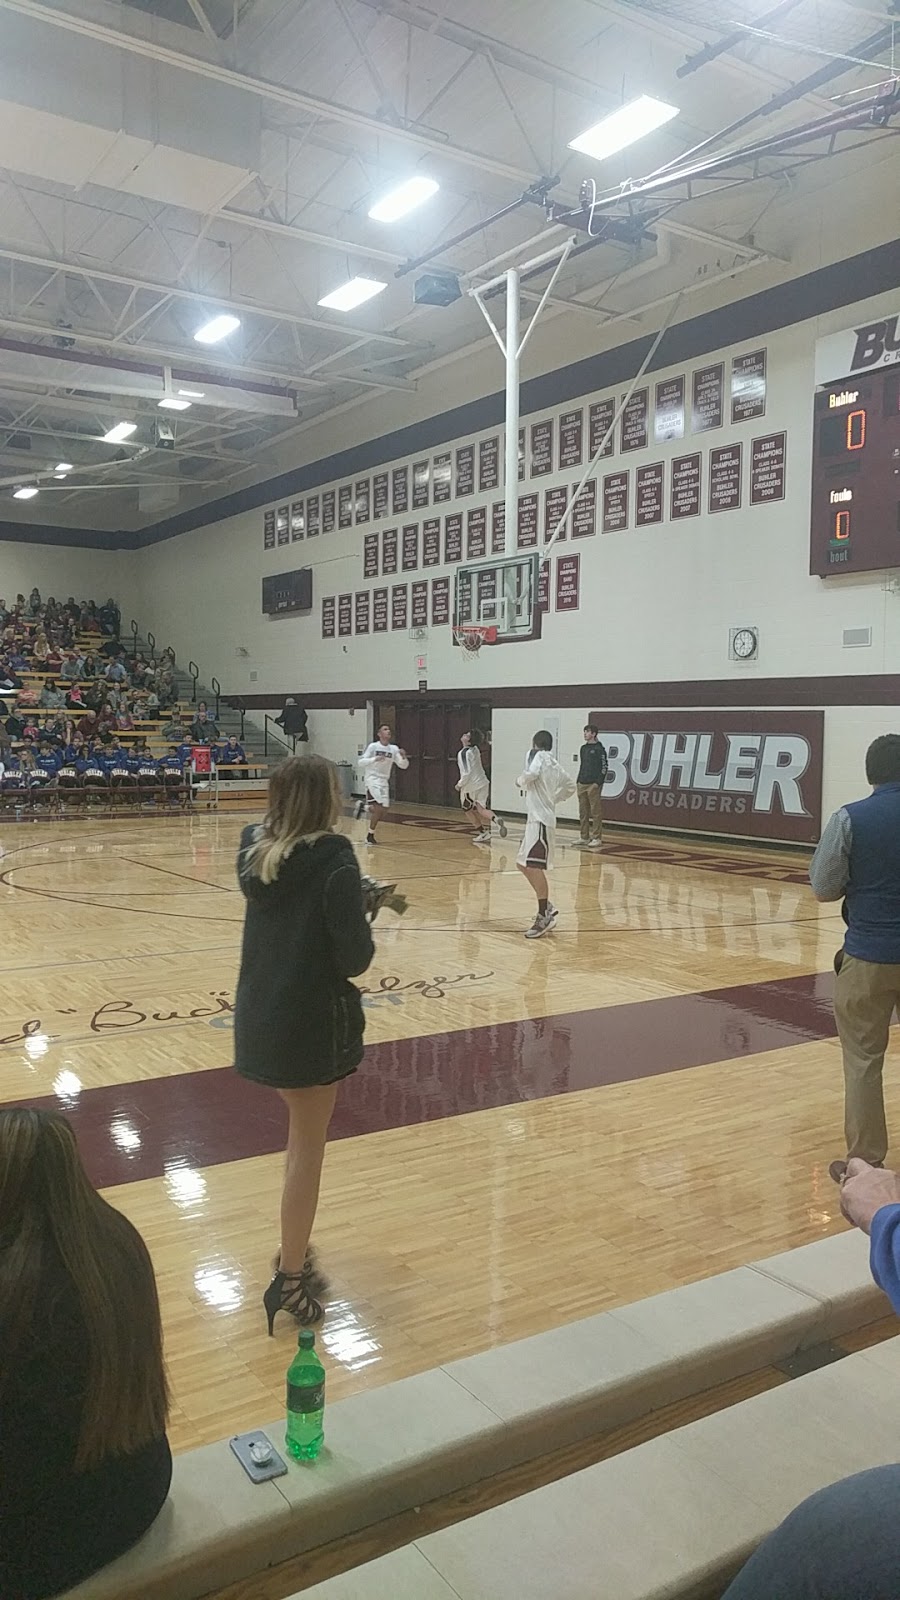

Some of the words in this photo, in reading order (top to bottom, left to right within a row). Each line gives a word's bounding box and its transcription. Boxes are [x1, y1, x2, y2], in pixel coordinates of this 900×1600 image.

[742, 356, 755, 367] STATE
[701, 372, 715, 382] STATE
[697, 379, 719, 390] CHAMPIONS
[699, 402, 715, 412] BUHLER
[735, 398, 761, 411] CRUSADERS
[847, 410, 866, 450] 0
[761, 441, 775, 451] STATE
[719, 452, 732, 461] STATE
[753, 447, 782, 461] CHAMPIONS
[680, 461, 692, 470] STATE
[712, 458, 739, 470] CHAMPIONS
[644, 470, 655, 478] STATE
[673, 467, 698, 479] CHAMPIONS
[758, 472, 776, 482] BUHLER
[638, 476, 661, 487] CHAMPIONS
[716, 481, 733, 490] BUHLER
[753, 478, 781, 490] CRUSADERS
[677, 490, 693, 499] BUHLER
[712, 488, 738, 498] CRUSADERS
[641, 498, 656, 506] BUHLER
[673, 496, 697, 506] CRUSADERS
[638, 504, 660, 514] CRUSADERS
[836, 510, 850, 539] 0
[597, 731, 813, 818] BUHLER
[625, 789, 747, 814] CRUSADERS
